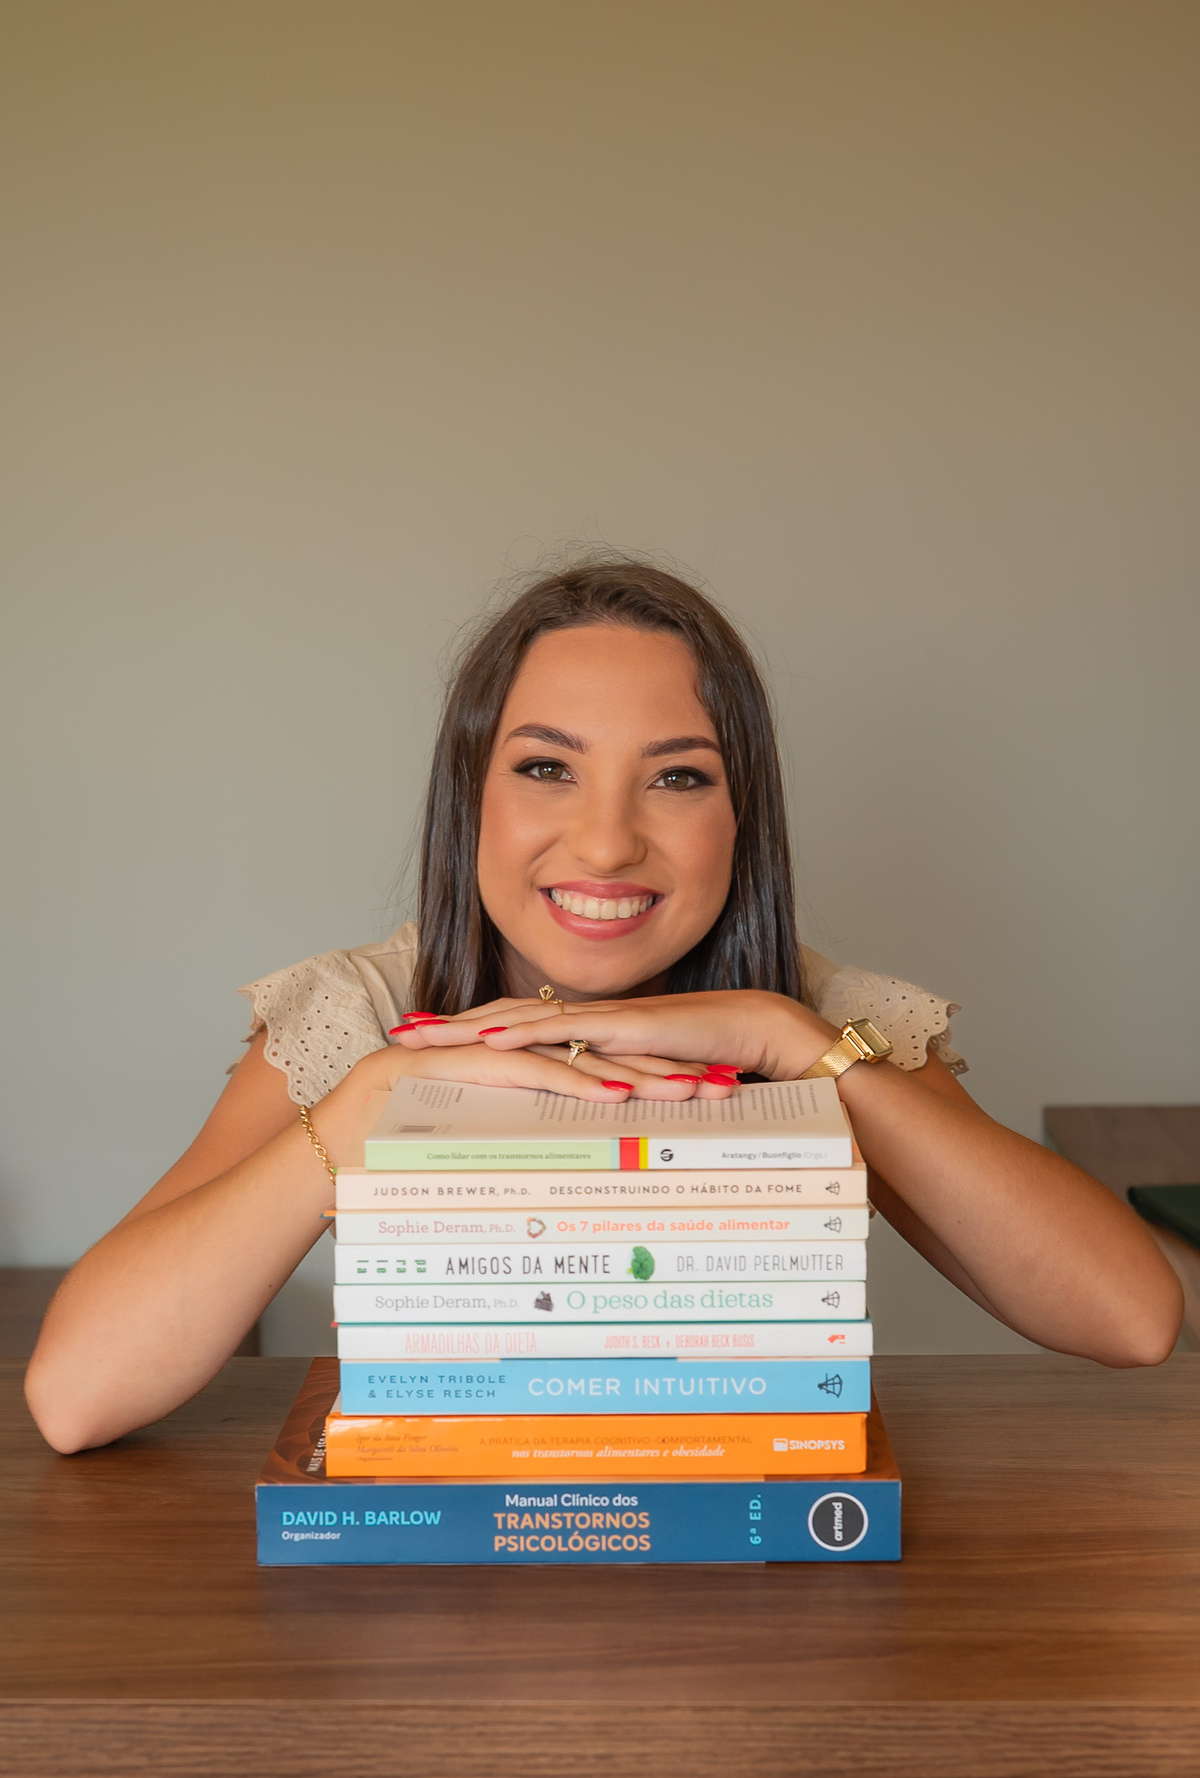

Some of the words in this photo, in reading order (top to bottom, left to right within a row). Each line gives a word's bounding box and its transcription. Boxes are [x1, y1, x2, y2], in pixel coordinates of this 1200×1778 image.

[373, 1187, 429, 1196] JUDSON
[437, 1187, 500, 1196] BREWER,
[504, 1187, 531, 1195] Ph.D.
[549, 1185, 671, 1195] DESCONSTRUINDO
[675, 1185, 686, 1194] O
[690, 1182, 741, 1194] HÁBITO
[745, 1184, 763, 1194] DA
[767, 1184, 803, 1193] FOME
[378, 1221, 429, 1236] Sophie
[433, 1221, 487, 1234] Deram,
[489, 1224, 515, 1233] Ph.D.
[557, 1221, 576, 1232] Os
[581, 1221, 588, 1232] 7
[592, 1220, 643, 1234] pilares
[646, 1220, 666, 1232] da
[669, 1219, 714, 1231] saúde
[718, 1219, 791, 1231] alimentar
[446, 1257, 512, 1274] AMIGOS
[522, 1256, 542, 1274] DA
[555, 1255, 611, 1273] MENTE
[677, 1255, 698, 1272] DR.
[707, 1255, 746, 1272] DAVID
[754, 1254, 844, 1271] PERLMUTTER
[375, 1295, 429, 1311] Sophie
[433, 1295, 490, 1310] Deram,
[493, 1299, 519, 1308] Ph.D.
[567, 1291, 585, 1310] O
[592, 1293, 648, 1313] peso
[653, 1290, 696, 1309] das
[700, 1289, 774, 1308] dietas
[405, 1332, 479, 1354] ARMADILHAS
[485, 1333, 500, 1353] DA
[506, 1332, 537, 1353] DIETA
[605, 1336, 630, 1349] JUDITH
[632, 1336, 639, 1348] S.
[642, 1335, 660, 1348] BECK
[675, 1335, 709, 1347] DEBORAH
[712, 1335, 730, 1347] BECK
[733, 1334, 755, 1347] BUSIS
[368, 1375, 429, 1384] EVELYN
[438, 1374, 507, 1384] TRIBOLE
[528, 1377, 620, 1396] COMER
[635, 1377, 767, 1395] INTUITIVO
[368, 1390, 377, 1398] &
[386, 1389, 434, 1398] ELYSE
[443, 1389, 496, 1398] RESCH
[533, 1437, 546, 1445] DA
[550, 1437, 591, 1445] TERAPIA
[790, 1440, 845, 1450] SINOPSYS
[512, 1450, 529, 1458] nos
[533, 1449, 593, 1458] transtornos
[596, 1445, 659, 1458] alimentares
[663, 1449, 670, 1457] e
[672, 1444, 725, 1457] obesidade
[505, 1493, 558, 1507] Manual
[560, 1493, 609, 1507] Clínico
[612, 1493, 638, 1507] dos
[749, 1494, 762, 1520] ED.
[281, 1510, 337, 1526] DAVID
[342, 1511, 360, 1526] H.
[364, 1510, 441, 1526] BARLOW
[494, 1512, 650, 1529] TRANSTORNOS
[832, 1502, 843, 1542] artmed
[281, 1531, 341, 1541] Organizador
[494, 1530, 651, 1552] PSICOLÓGICOS
